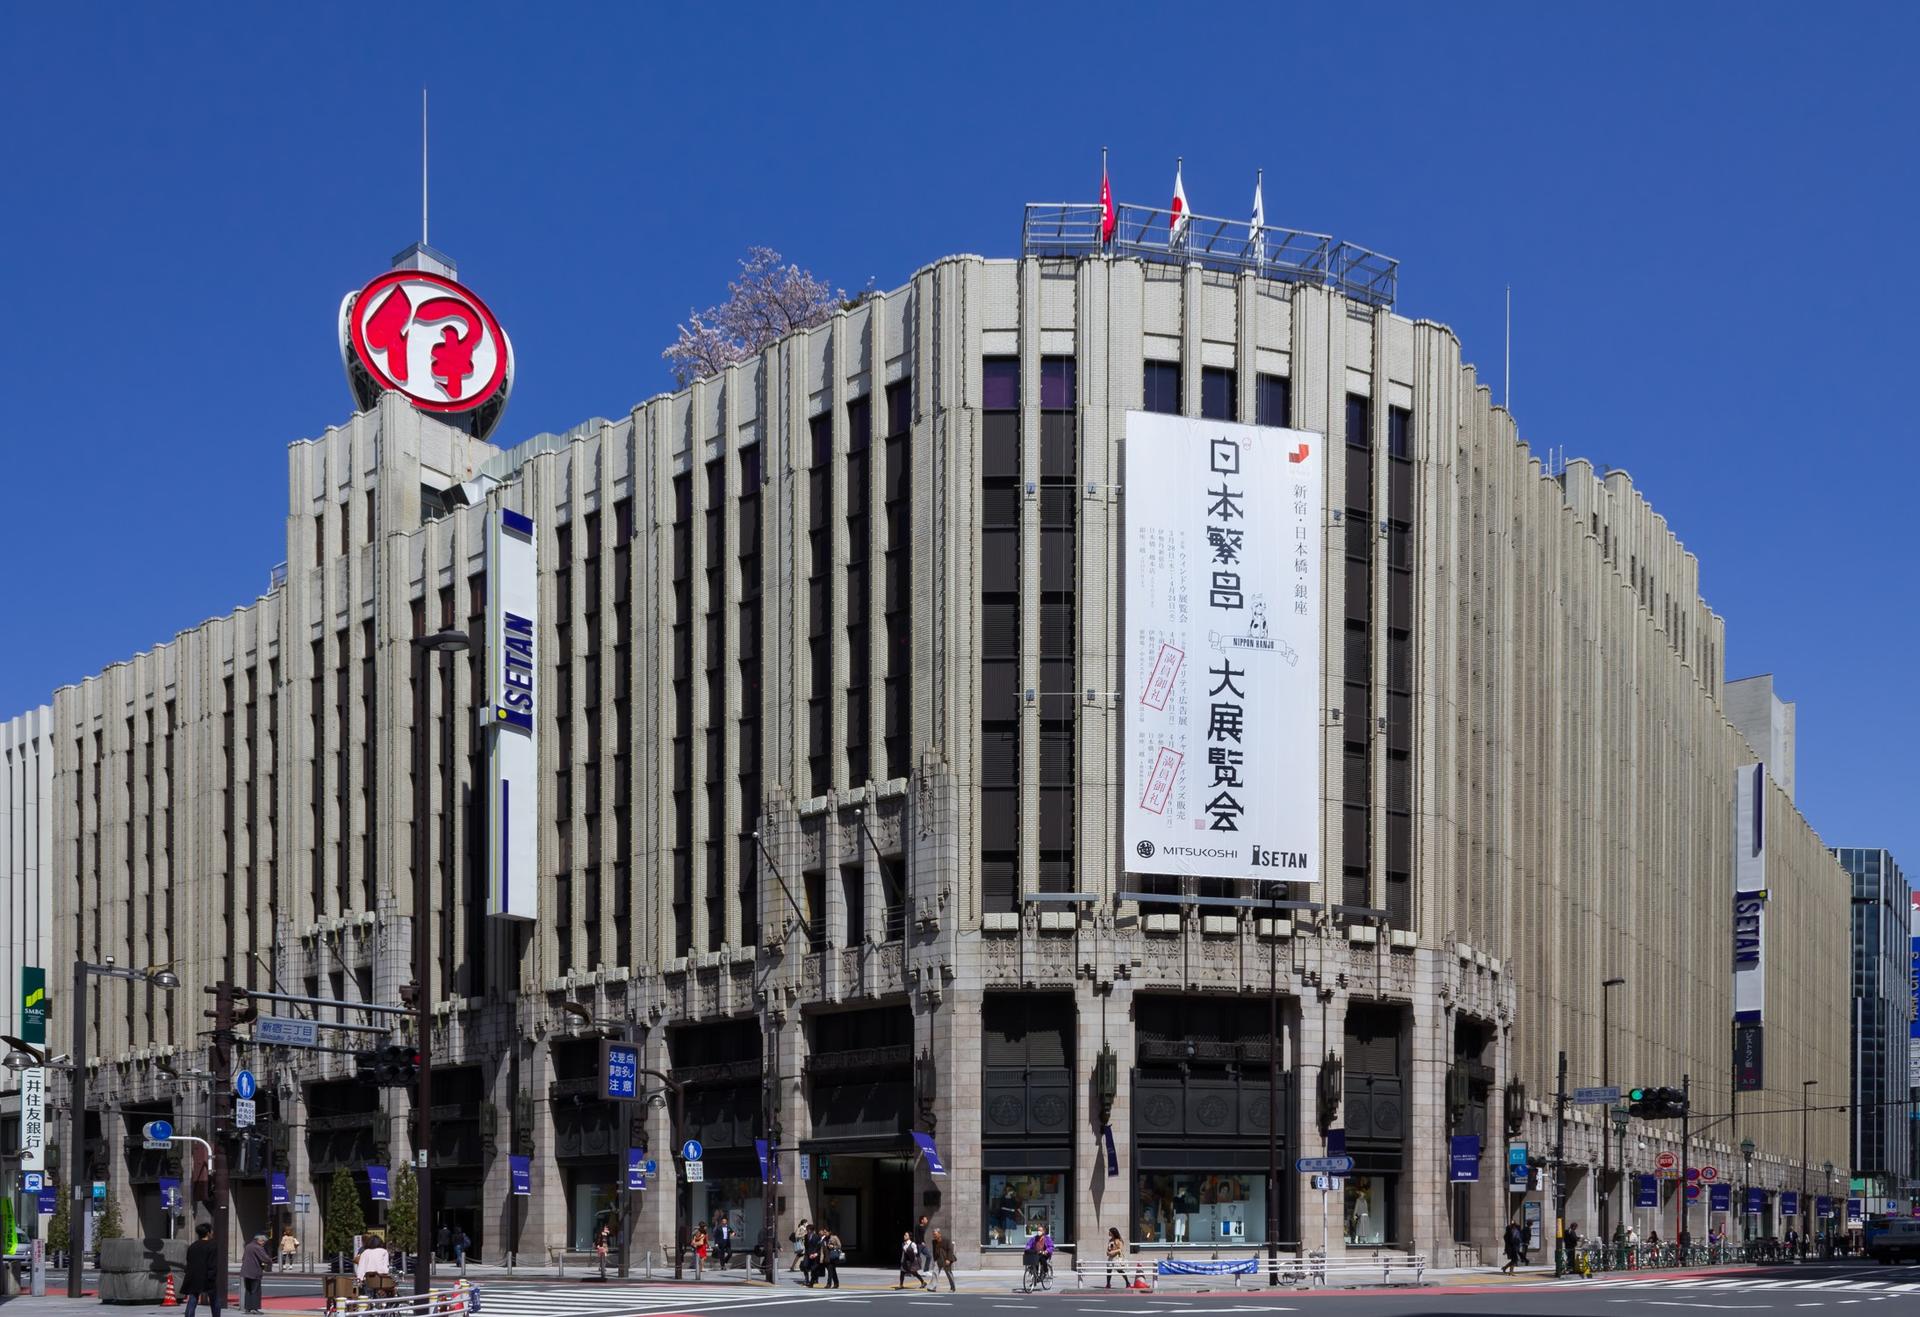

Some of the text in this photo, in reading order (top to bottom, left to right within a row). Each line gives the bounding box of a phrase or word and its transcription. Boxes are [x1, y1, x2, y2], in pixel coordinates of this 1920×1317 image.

[1295, 484, 1308, 615] 新宿・日本橋・銀座
[1205, 436, 1244, 833] 日本繁昌 大展覧会
[1233, 638, 1254, 648] NIPPON
[1150, 652, 1177, 703] 満員御礼
[1150, 755, 1175, 806] 満員御礼
[1163, 846, 1238, 859] MITSUKOSHI
[1252, 845, 1307, 868] ISETAN
[25, 1008, 44, 1016] SMBC
[261, 1022, 312, 1037] 新宿三丁目
[609, 1051, 634, 1064] 交差点
[609, 1079, 632, 1092] 注意
